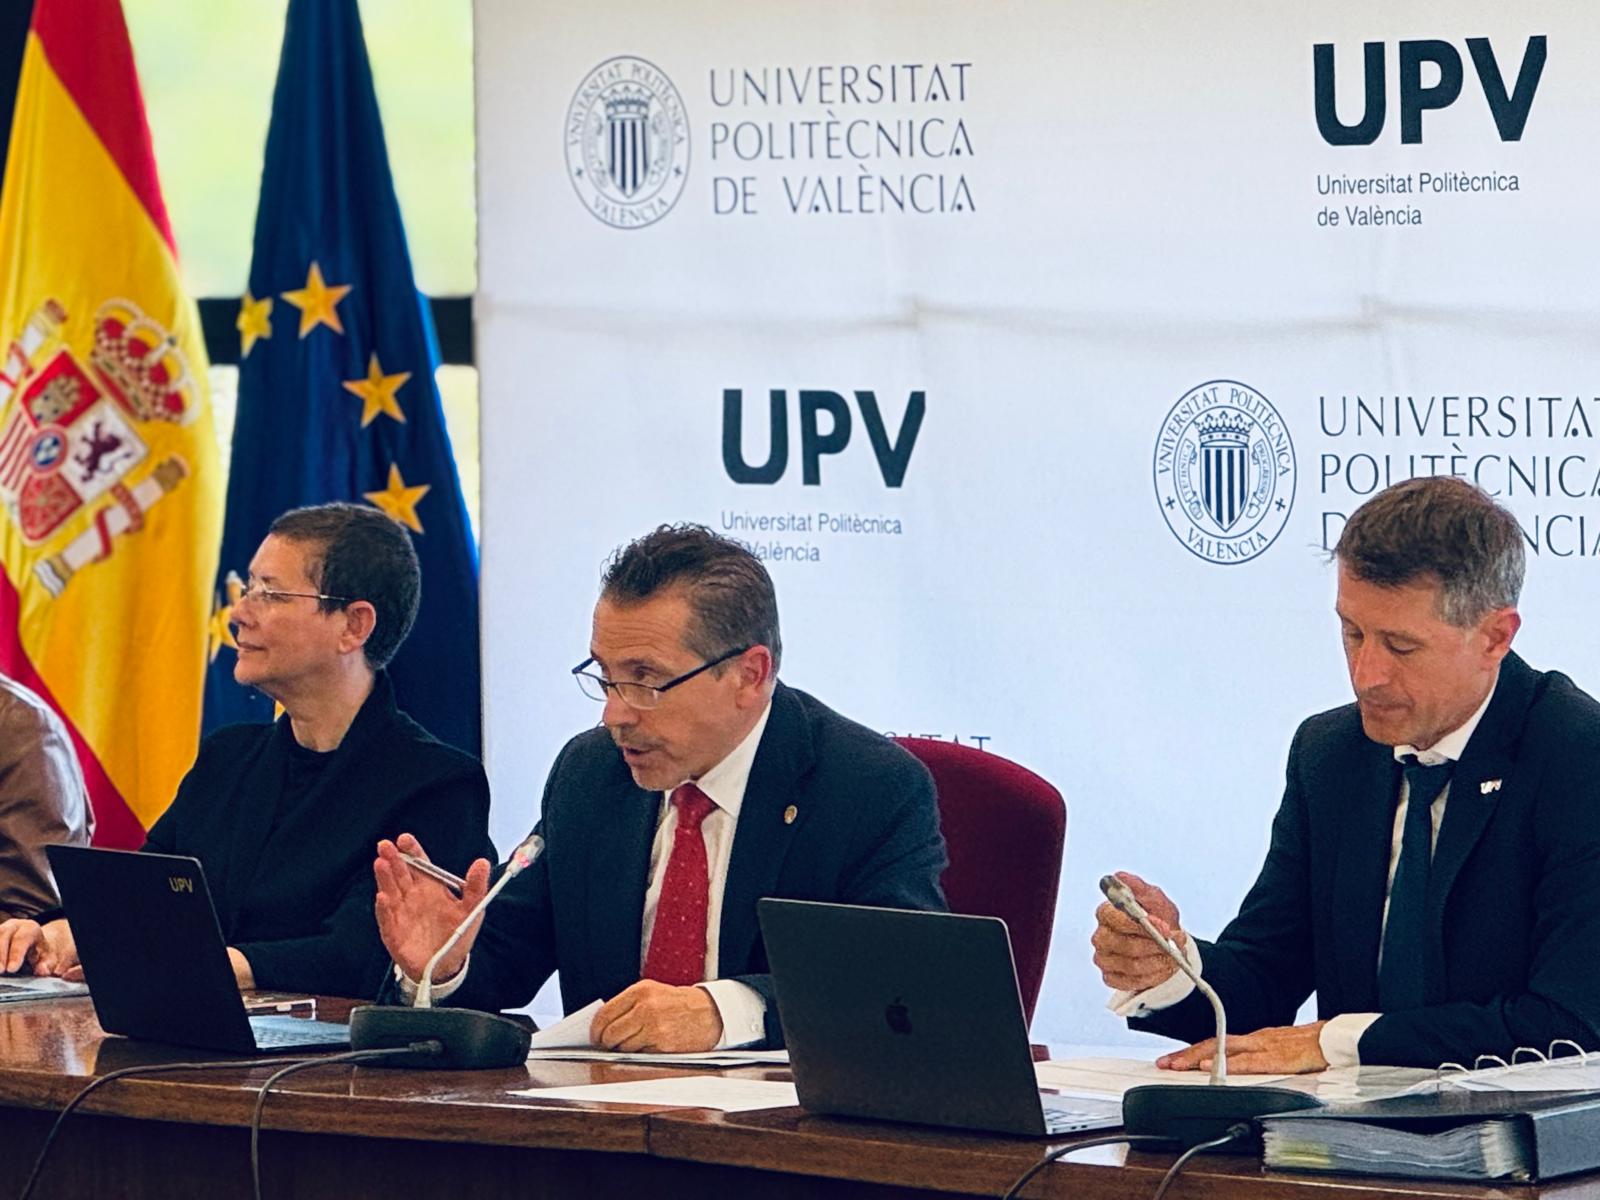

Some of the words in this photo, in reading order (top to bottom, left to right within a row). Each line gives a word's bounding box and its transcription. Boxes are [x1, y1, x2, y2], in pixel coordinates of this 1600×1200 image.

[710, 63, 972, 107] UNIVERSITAT
[1313, 35, 1548, 147] UPV
[711, 109, 974, 160] POLITÈCNICA
[712, 176, 758, 215] DE
[782, 164, 977, 214] VALÈNCIA
[1317, 173, 1413, 196] Universitat
[1419, 170, 1520, 193] Politècnica
[1317, 206, 1340, 227] de
[1345, 204, 1423, 226] València
[722, 388, 926, 488] UPV
[1319, 395, 1600, 438] UNIVERSITA
[721, 511, 812, 532] Universitat
[818, 512, 903, 535] Politècnica
[168, 877, 193, 893] UPV
